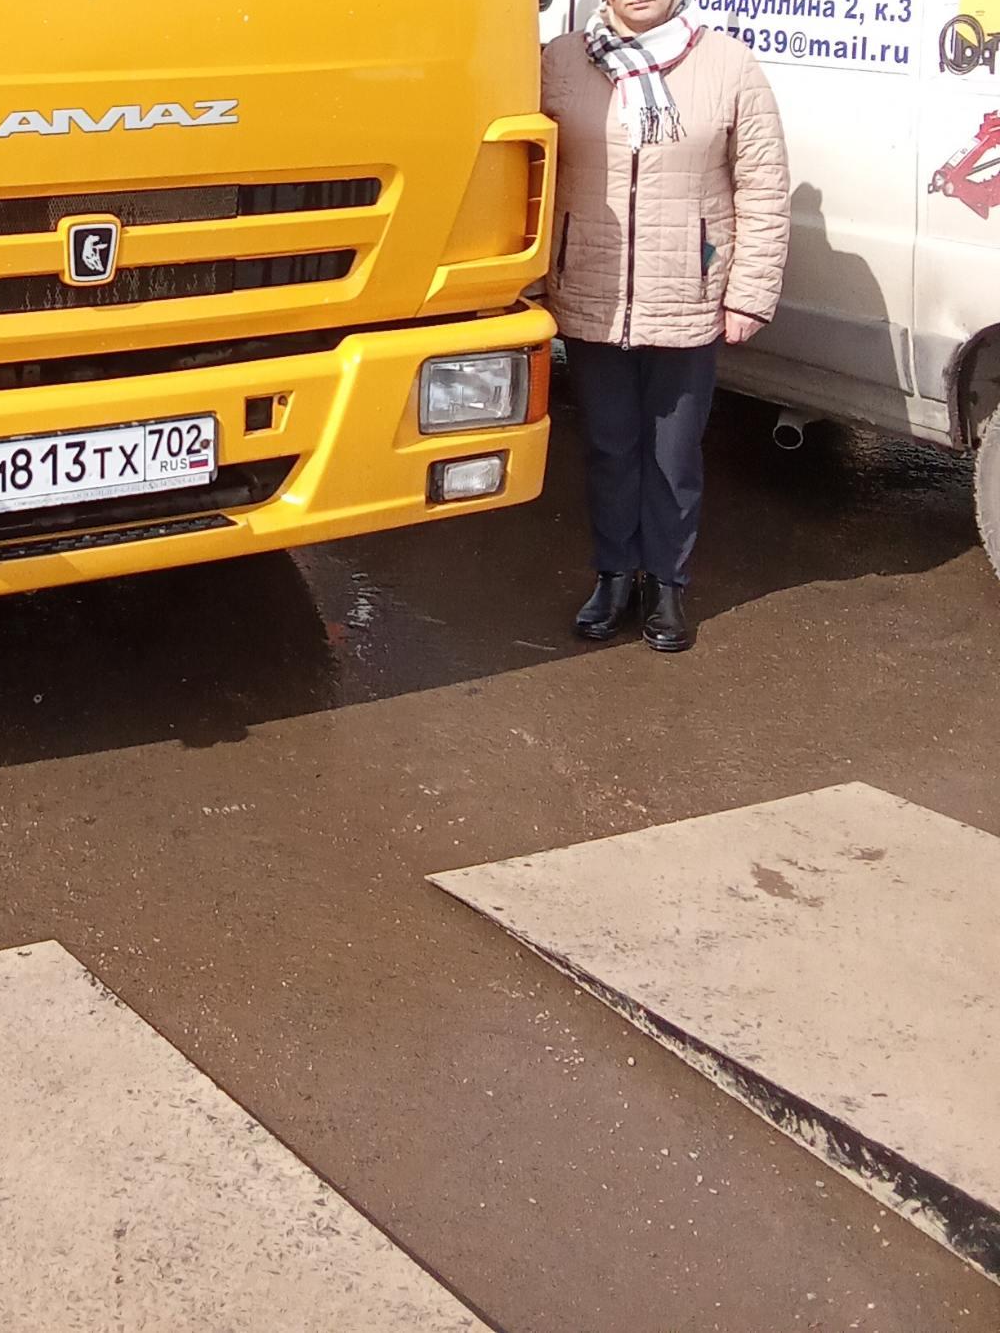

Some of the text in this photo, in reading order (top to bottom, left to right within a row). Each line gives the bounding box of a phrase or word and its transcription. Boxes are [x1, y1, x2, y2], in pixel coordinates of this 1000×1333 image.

[700, 24, 910, 65] 7939@mail.ru
[147, 423, 203, 461] 702
[159, 457, 188, 473] RUS
